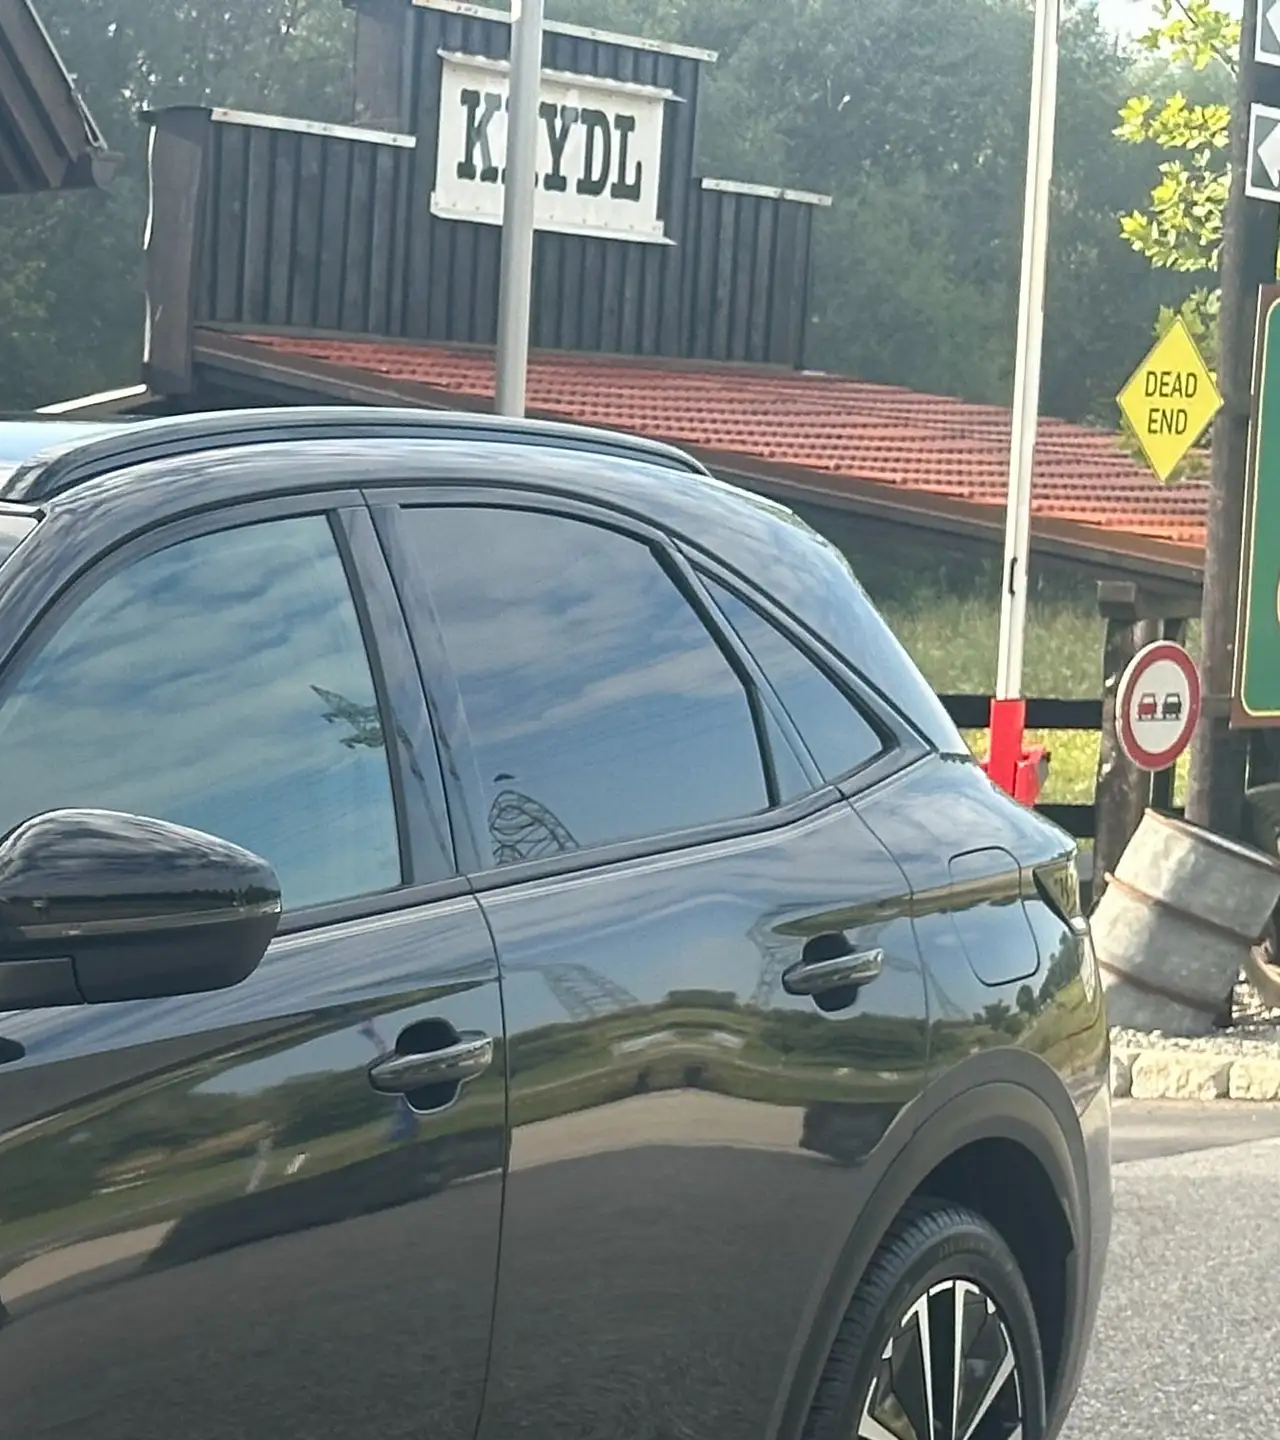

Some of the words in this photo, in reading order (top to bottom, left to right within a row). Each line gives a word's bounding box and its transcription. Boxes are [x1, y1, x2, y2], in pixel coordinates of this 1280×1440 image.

[456, 87, 643, 203] KYDL
[1144, 370, 1198, 399] DEAD
[1147, 407, 1189, 436] END
